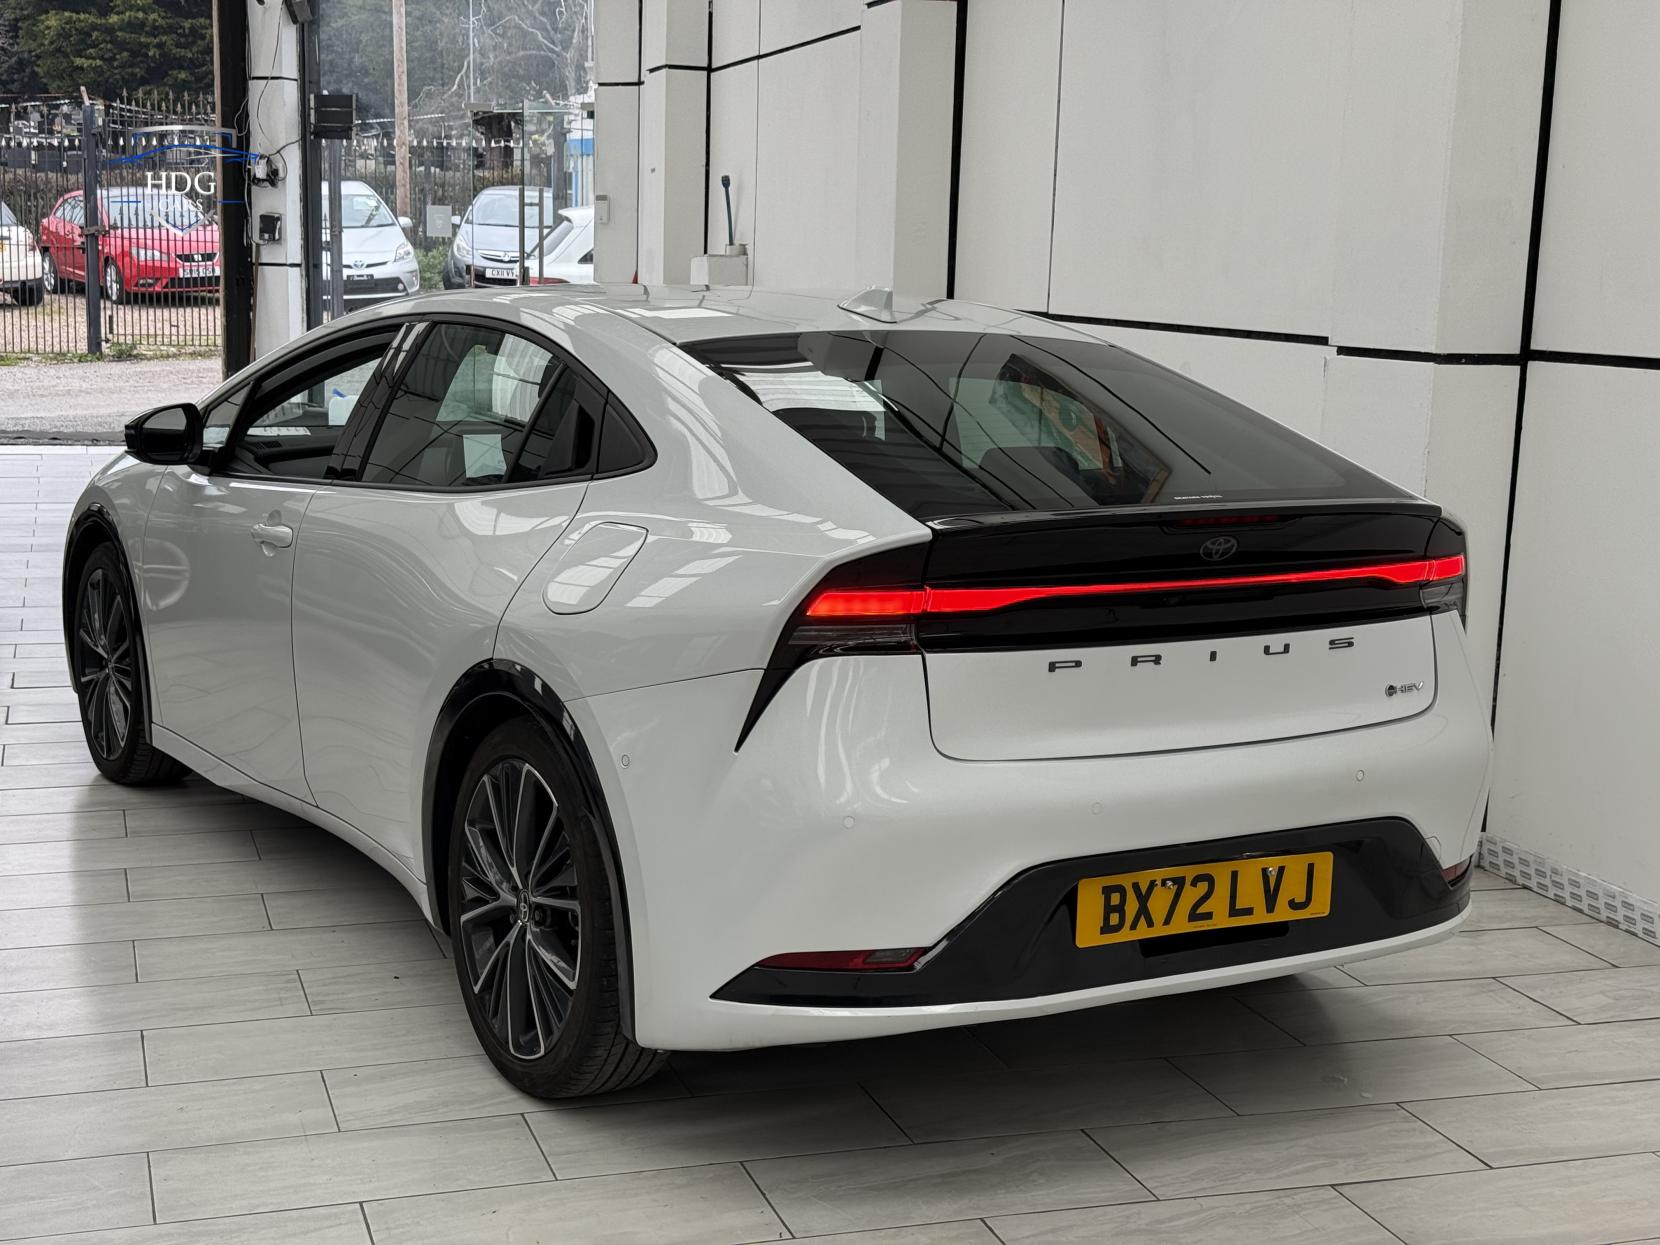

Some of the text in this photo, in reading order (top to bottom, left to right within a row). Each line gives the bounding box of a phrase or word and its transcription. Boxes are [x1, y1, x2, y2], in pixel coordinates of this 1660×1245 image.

[1047, 637, 1354, 672] PRIUS
[1099, 862, 1316, 936] BX72 LVJ
